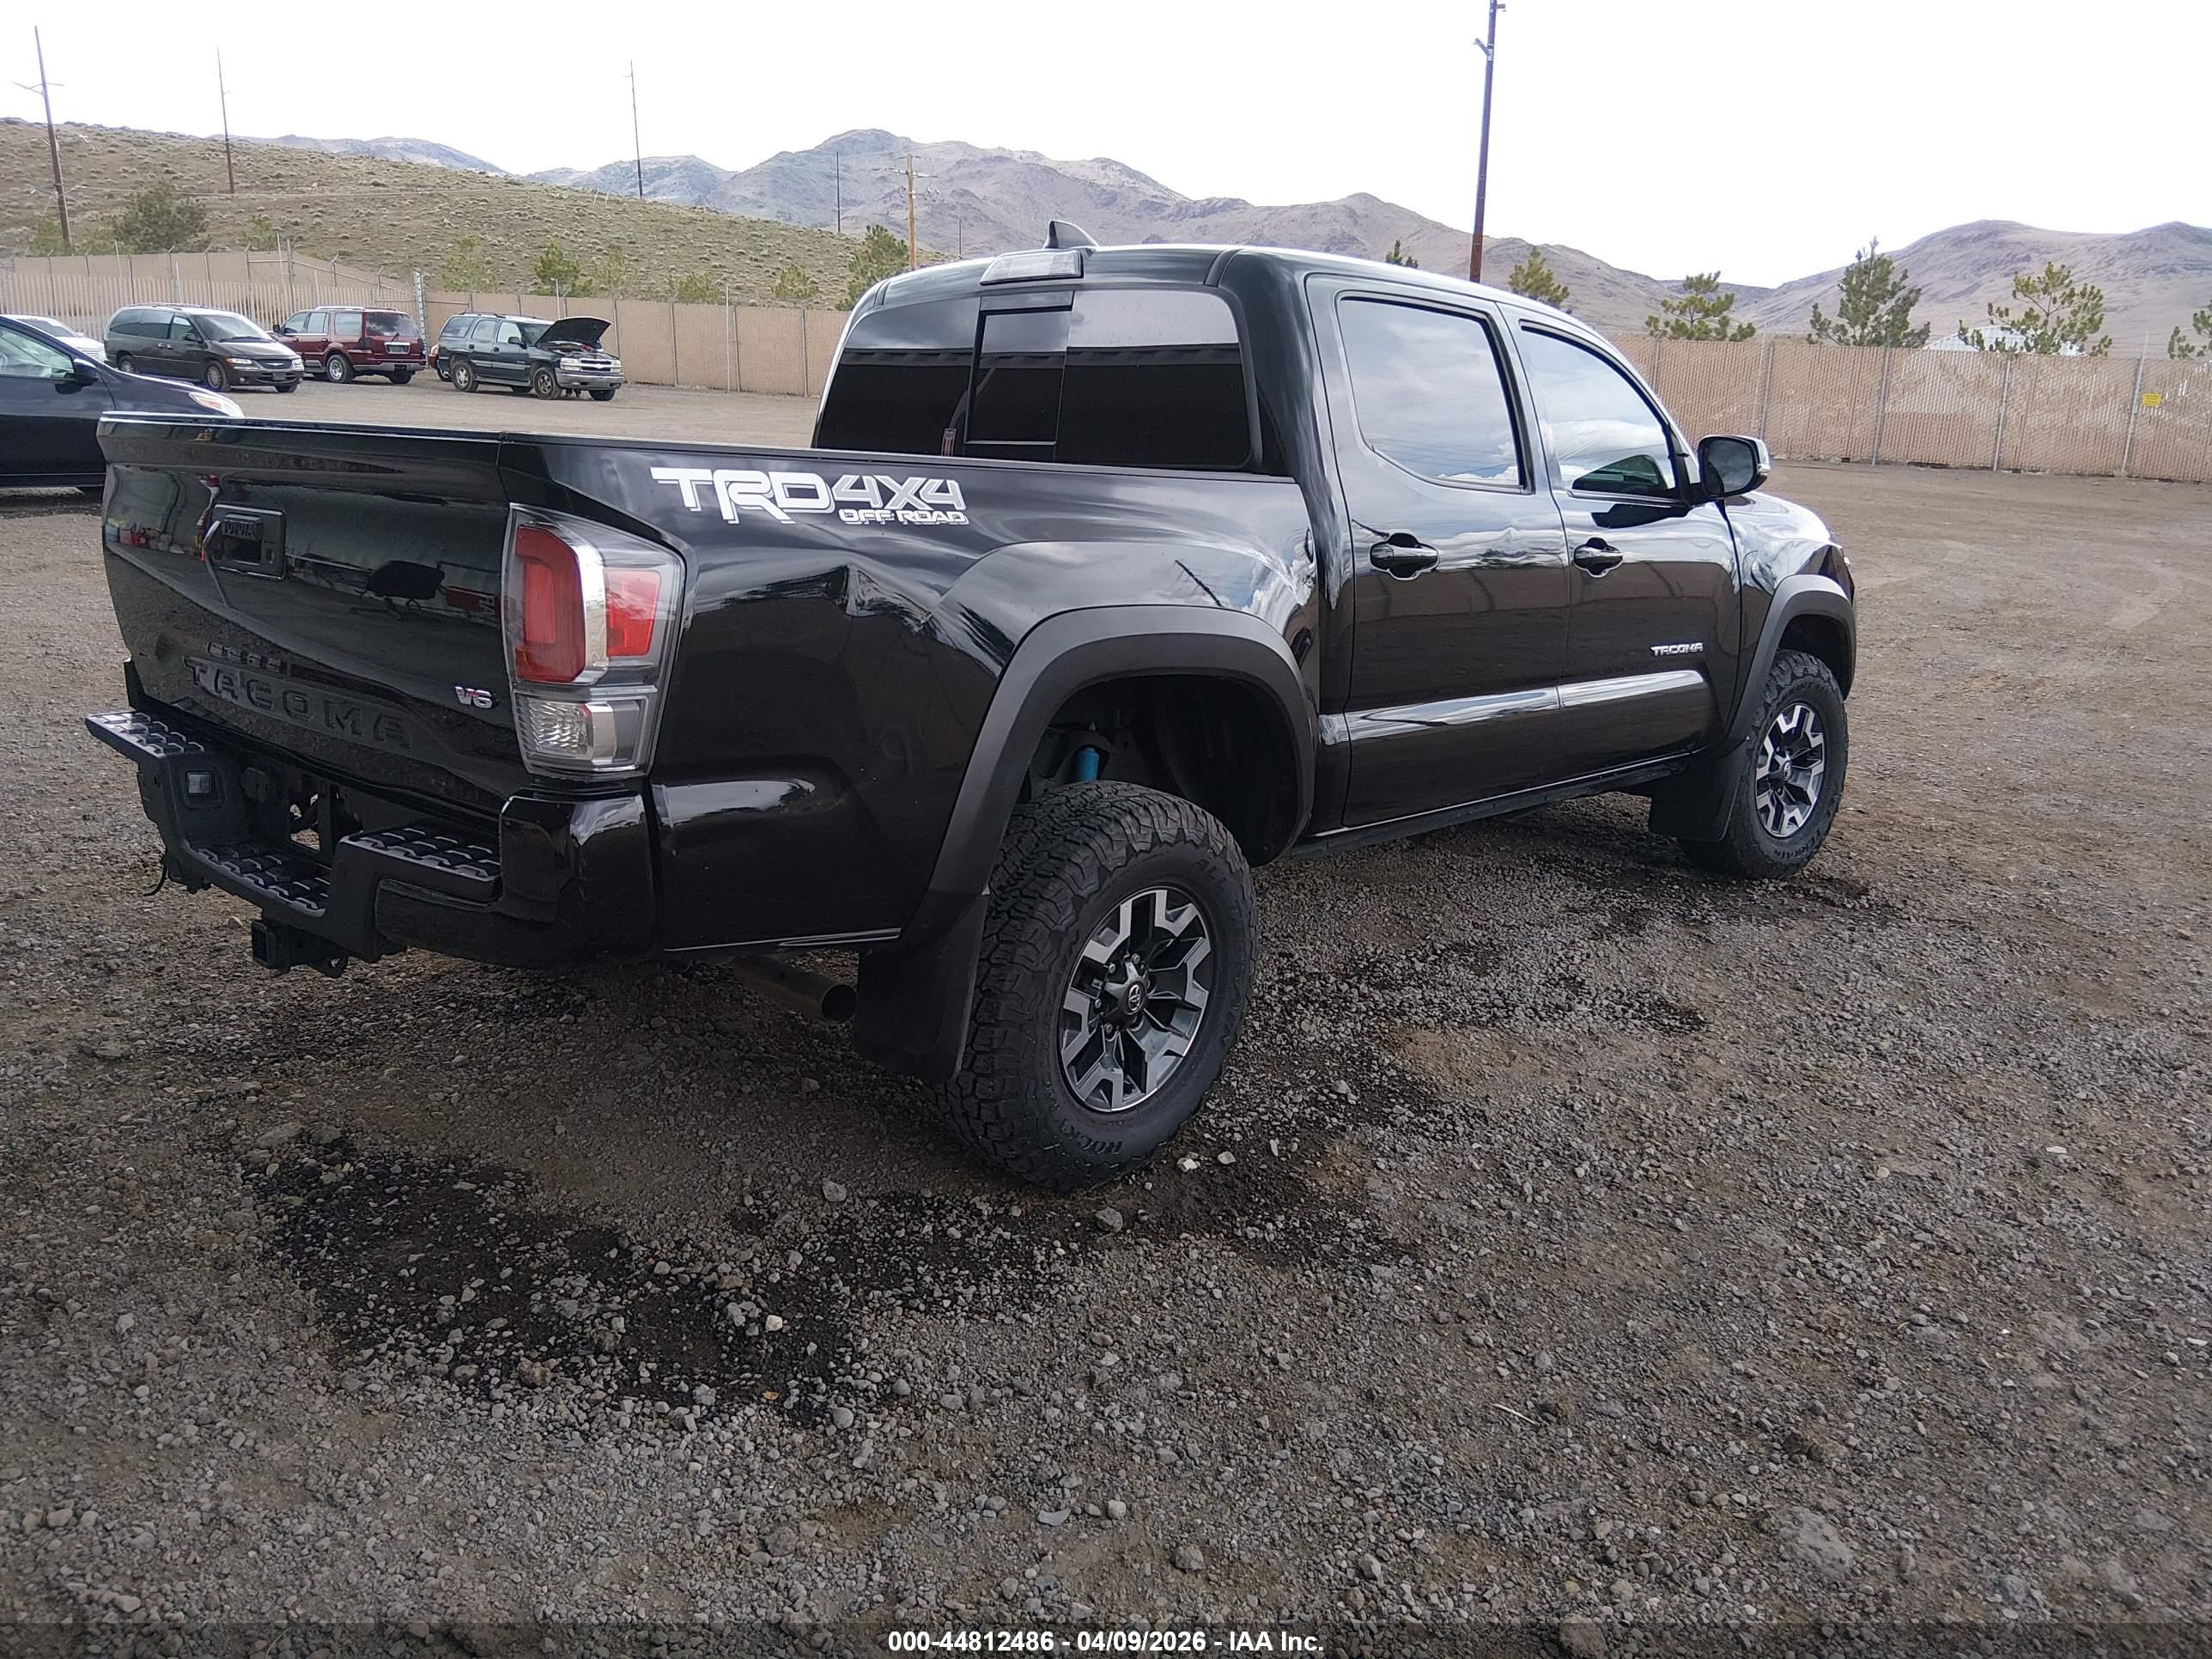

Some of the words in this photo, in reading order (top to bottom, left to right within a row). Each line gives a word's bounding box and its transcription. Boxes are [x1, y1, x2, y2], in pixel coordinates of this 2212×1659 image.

[650, 467, 836, 525] TRD
[839, 508, 894, 526] OFF
[896, 509, 969, 526] ROAD
[221, 519, 258, 538] TOYOTA
[1650, 642, 1704, 657] TACOMA
[183, 655, 413, 749] TACOMA
[454, 686, 493, 709] V6
